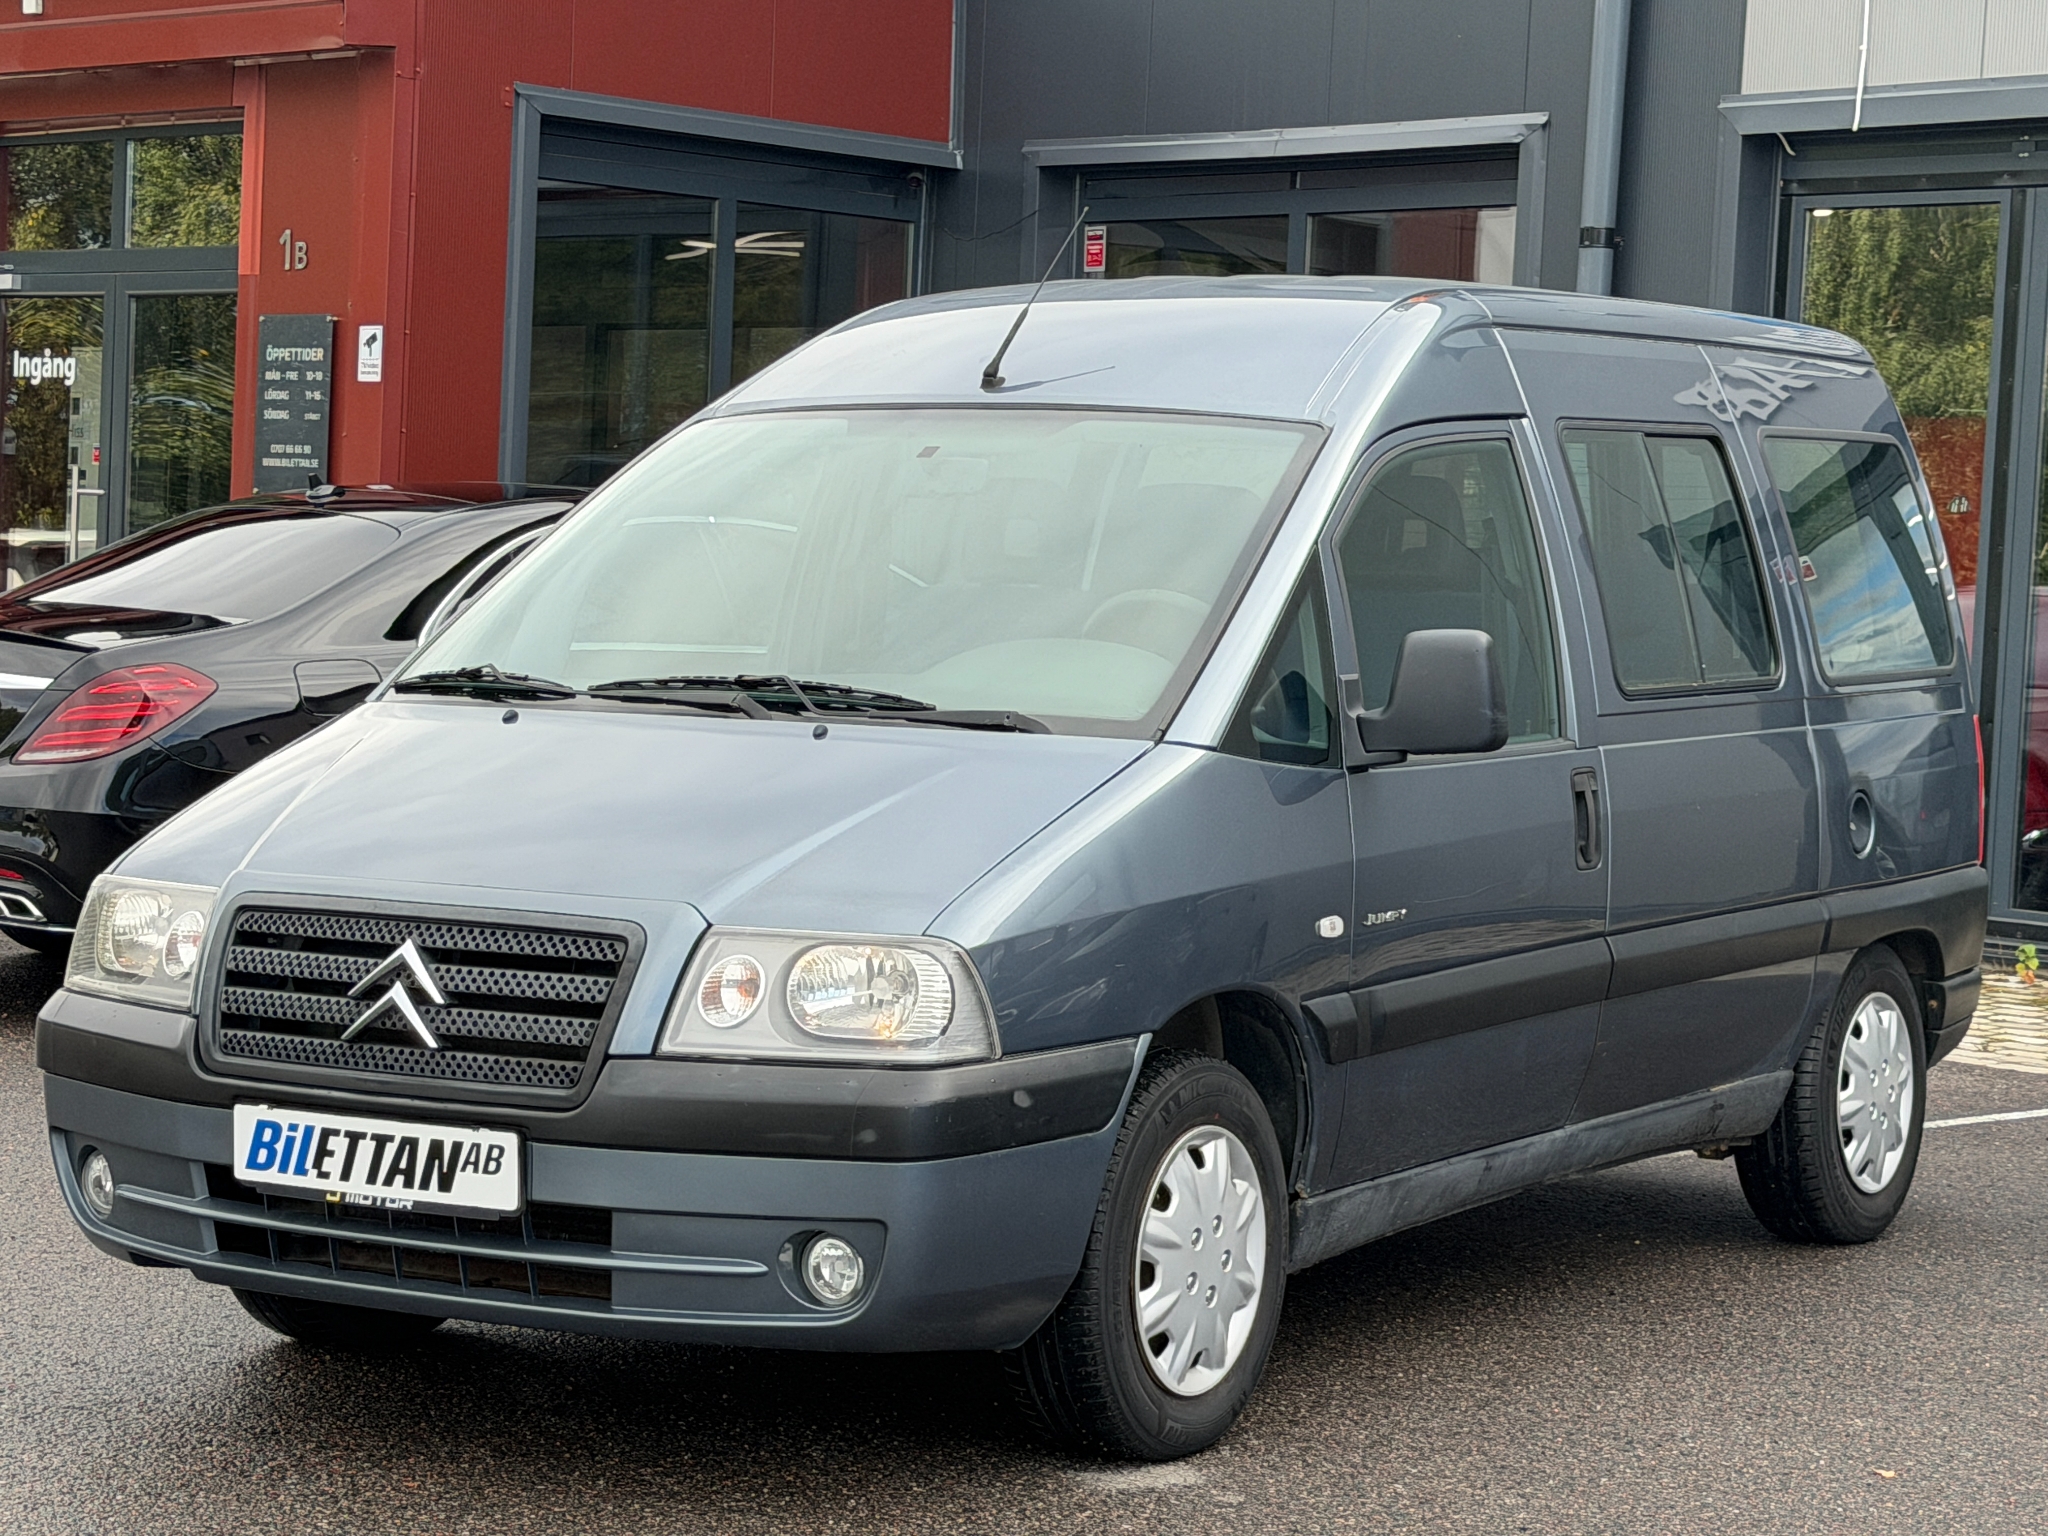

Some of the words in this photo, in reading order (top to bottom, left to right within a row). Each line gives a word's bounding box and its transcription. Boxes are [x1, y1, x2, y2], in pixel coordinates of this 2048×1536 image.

[266, 345, 323, 361] ÖPPETTIDER
[13, 348, 75, 386] Ingång
[264, 388, 289, 400] LÖRDAG
[459, 1142, 506, 1176] AB
